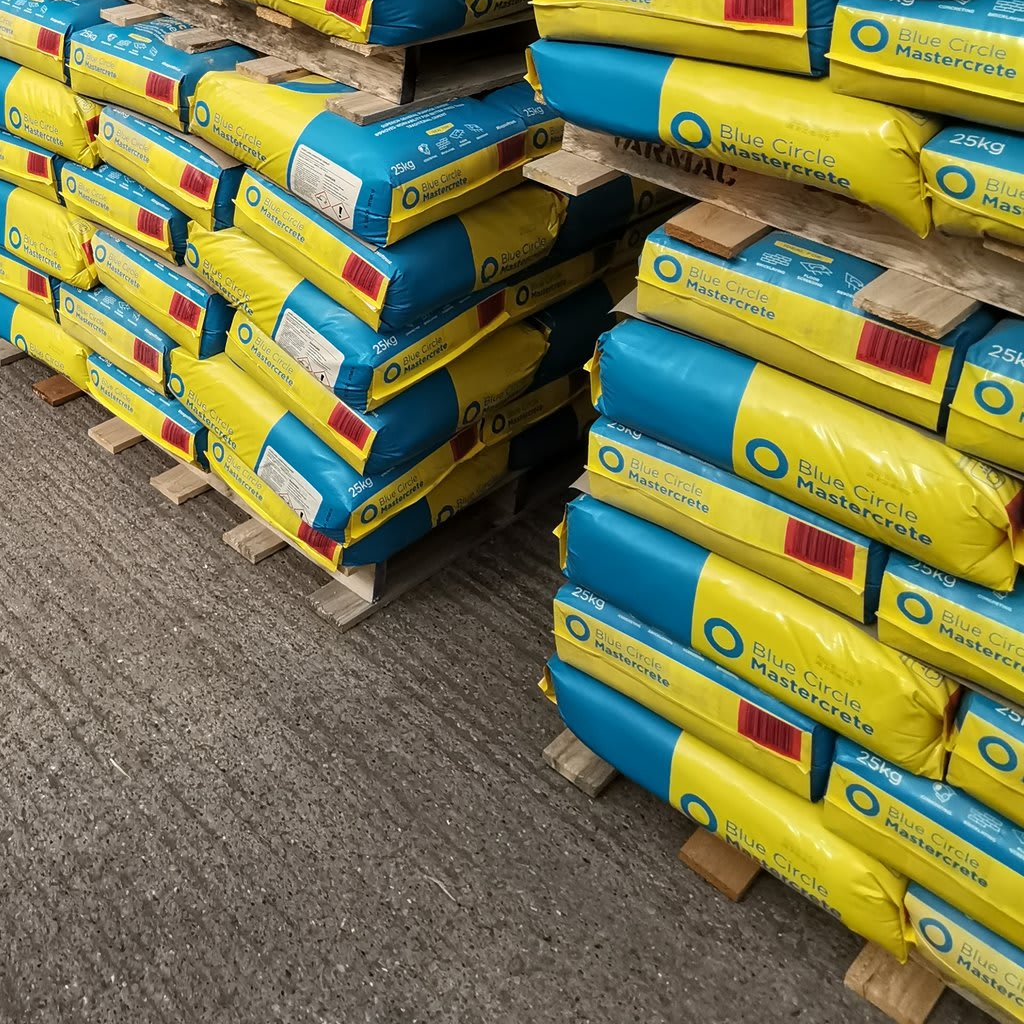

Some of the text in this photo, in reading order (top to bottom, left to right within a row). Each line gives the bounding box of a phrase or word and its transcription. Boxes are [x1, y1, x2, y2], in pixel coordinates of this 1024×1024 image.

[895, 43, 1018, 80] Mastercrete
[897, 28, 1007, 61] Blue Circle
[212, 125, 267, 163] Mastercrete
[213, 112, 263, 148] Blue Circle
[719, 123, 837, 168] Blue Circle
[948, 133, 1006, 155] 25kg
[390, 159, 416, 176] 25kg
[421, 168, 462, 192] Blue Circle
[720, 141, 851, 189] Mastercrete
[422, 176, 468, 202] Mastercrete
[259, 207, 305, 244] Mastercrete
[263, 196, 305, 230] Blue Circle
[685, 279, 776, 321] Mastercrete
[688, 266, 721, 287] Blue
[726, 278, 769, 303] Circle
[373, 336, 398, 354] 25kg
[403, 336, 444, 367] Blue Circle
[403, 342, 448, 374] Mastercrete
[186, 401, 237, 449] Mastercrete
[187, 389, 234, 436] Blue Circle
[348, 477, 373, 497] 25kg
[379, 476, 417, 507] Blue Circle
[628, 470, 710, 514] Mastercrete
[629, 458, 704, 497] Blue Circle
[799, 459, 918, 522] Blue Circle
[380, 481, 424, 514] Mastercrete
[796, 478, 933, 546] Mastercrete
[571, 587, 606, 610] 25kg
[594, 641, 671, 688] Mastercrete
[596, 629, 663, 672] Blue Circle
[752, 641, 862, 711] Blue Circle
[750, 658, 874, 736] Mastercrete
[856, 751, 903, 785] 25kg
[884, 817, 988, 888] Mastercrete
[888, 807, 980, 869] Blue Circle
[725, 819, 829, 896] Blue Circle
